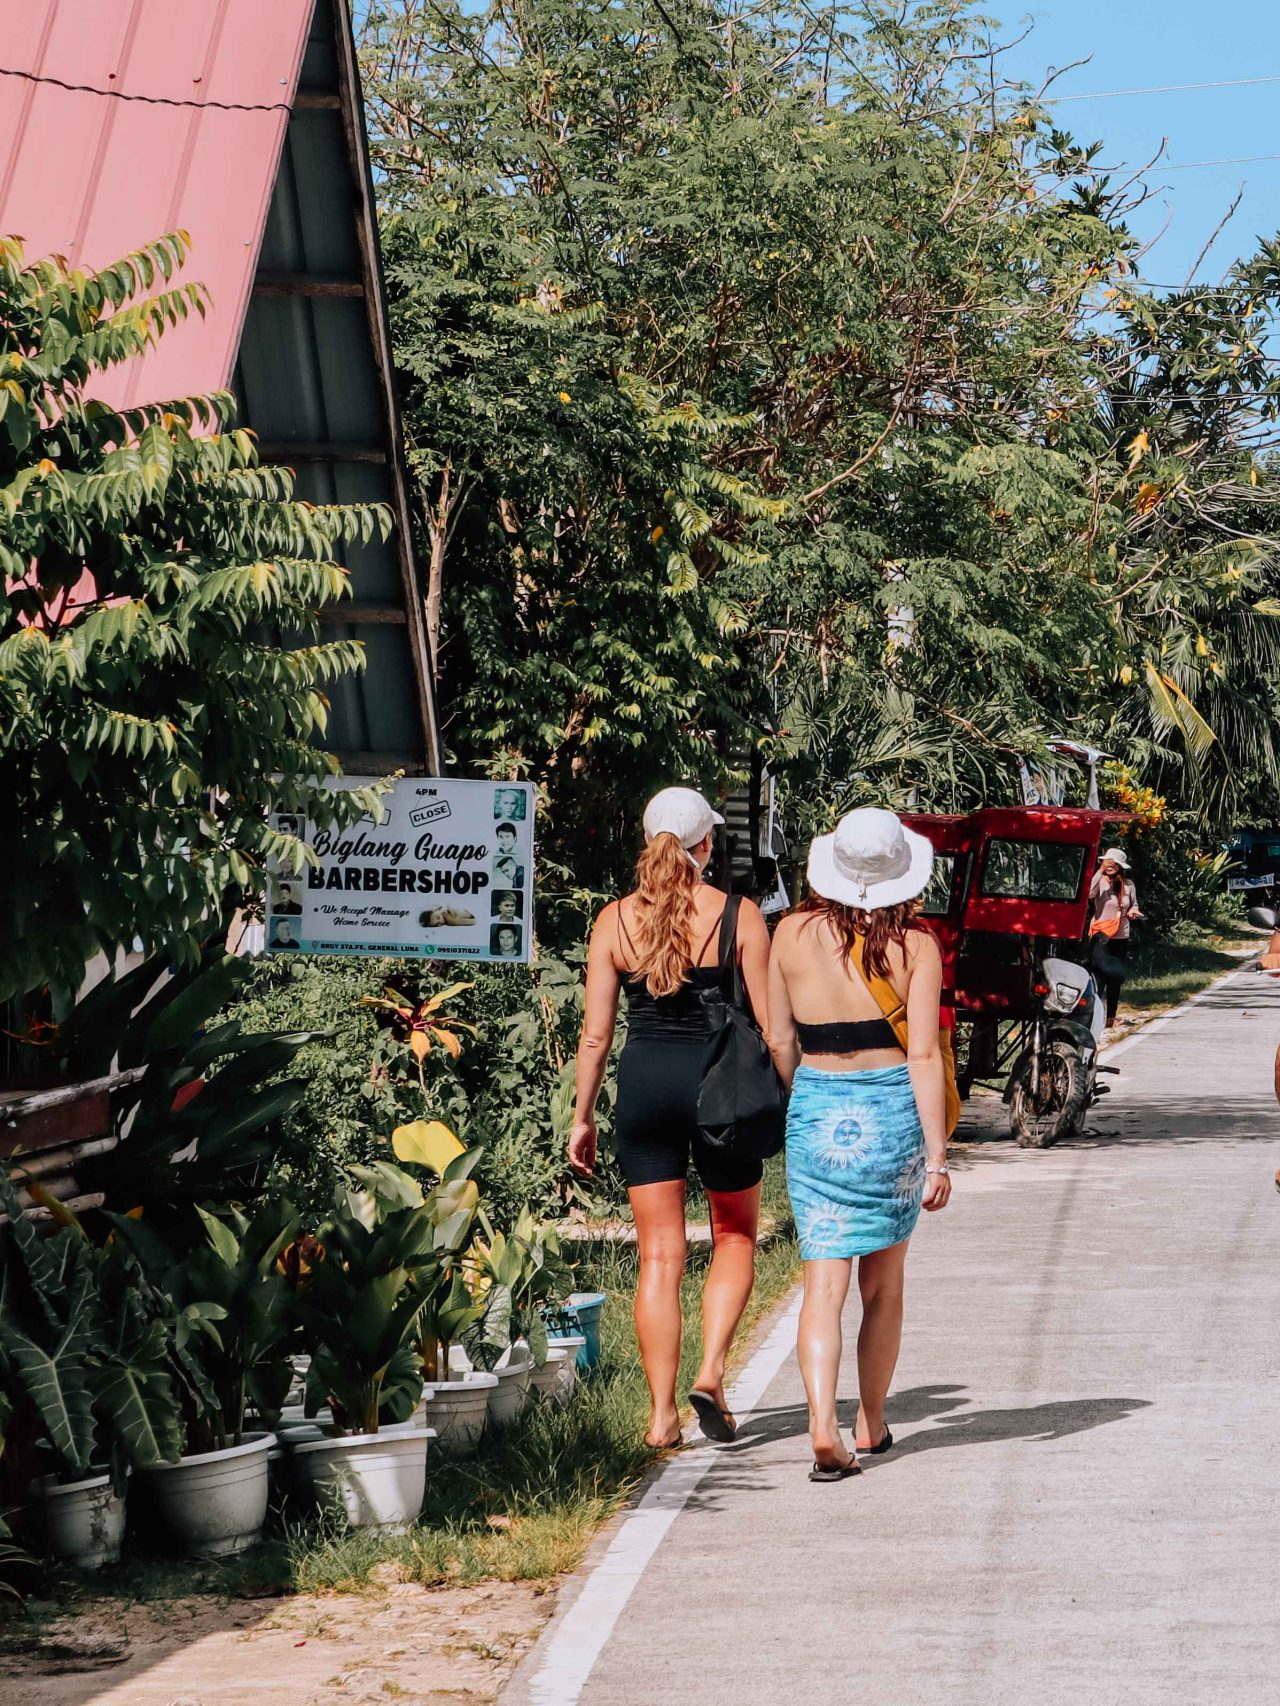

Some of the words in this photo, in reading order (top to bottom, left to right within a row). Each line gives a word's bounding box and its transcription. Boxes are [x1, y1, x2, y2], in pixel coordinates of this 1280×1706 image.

[416, 788, 437, 796] 4PM
[413, 805, 448, 822] CLOSE
[313, 829, 408, 865] Biglang
[415, 832, 489, 870] Guapo
[308, 866, 489, 894] BARBERSHOP
[321, 905, 337, 914] We
[340, 905, 368, 917] Accept
[370, 906, 410, 918] Massage
[333, 917, 358, 926] Home
[361, 918, 391, 927] Service
